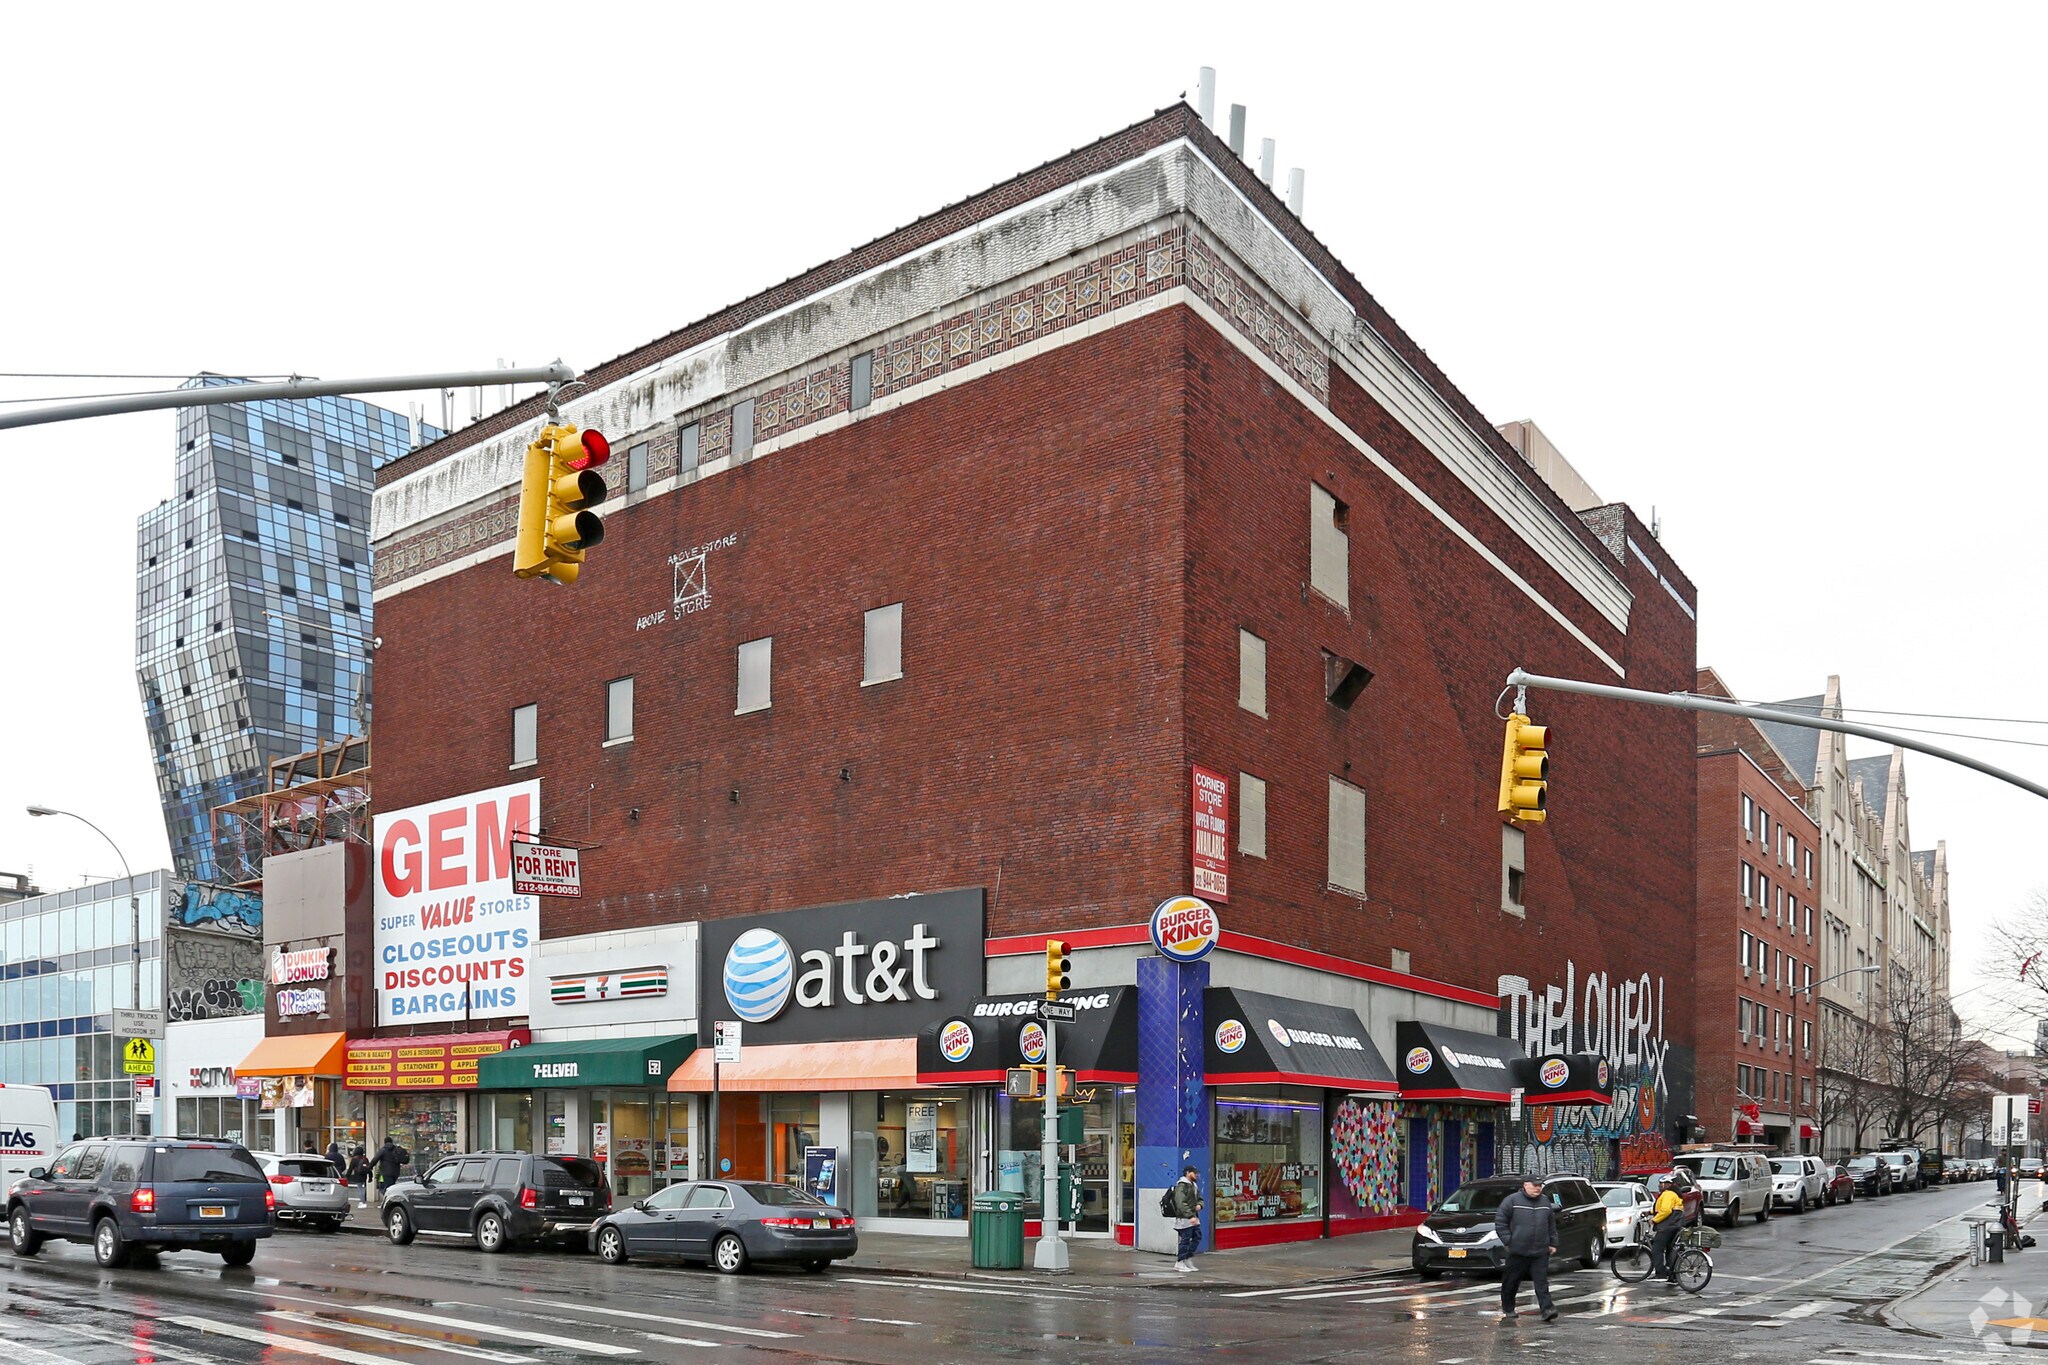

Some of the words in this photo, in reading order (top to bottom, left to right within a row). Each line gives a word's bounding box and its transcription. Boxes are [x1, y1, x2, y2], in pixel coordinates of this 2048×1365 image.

[702, 532, 737, 552] STORE
[636, 610, 667, 631] ABOVE
[674, 594, 712, 620] STORE
[1195, 773, 1225, 794] CORNER
[1199, 788, 1222, 807] STORE
[1208, 805, 1214, 814] &
[1196, 812, 1209, 829] UPPER
[1210, 816, 1225, 834] FLOORS
[381, 793, 530, 898] GEM
[531, 847, 561, 858] STORE
[1196, 829, 1225, 860] AVAILABLE
[516, 856, 541, 875] FOR
[545, 858, 576, 878] RENT
[1206, 860, 1216, 869] CALL
[518, 883, 578, 895] 212-944-0055
[1203, 871, 1225, 893] 944-0055
[381, 914, 415, 930] SUPER
[421, 896, 476, 930] VALUE
[480, 896, 530, 916] STORES
[1160, 908, 1211, 930] BURGER
[1161, 919, 1213, 947] KING
[383, 928, 528, 964] CLOSEOUTS
[287, 949, 329, 967] DUNKIN'
[795, 923, 940, 1008] at&t
[287, 964, 326, 982] DONUTS
[385, 957, 524, 990] DISCOUNTS
[296, 989, 320, 1001] baskin
[392, 987, 516, 1016] BARGAINS
[138, 1012, 158, 1020] TRUCKS
[296, 1002, 320, 1013] robbins
[973, 1000, 1038, 1017] BURGE
[1042, 1006, 1054, 1015] ONE
[1059, 1008, 1071, 1016] WAY
[1498, 974, 1564, 1058] THE
[944, 1027, 968, 1044] BURGER
[1023, 1030, 1043, 1043] BURGER
[1220, 1025, 1242, 1038] BURGER
[1220, 1030, 1243, 1046] KING
[1287, 1028, 1336, 1047] BURGER
[1332, 1035, 1364, 1050] KING
[418, 1048, 443, 1056] DETERGENTS
[452, 1046, 477, 1054] HOUSEHOLD
[946, 1034, 970, 1053] KING
[1023, 1038, 1044, 1053] KING
[1410, 1051, 1428, 1062] BURGER
[1410, 1056, 1430, 1068] KING
[1454, 1052, 1486, 1066] BURGER
[1483, 1056, 1506, 1070] KING
[1544, 1064, 1564, 1075] BURGER
[1544, 1068, 1566, 1082] KING
[406, 1076, 434, 1084] LUGGAGE
[908, 1106, 935, 1116] FREE
[1282, 1165, 1287, 1180] 2
[1262, 1206, 1276, 1218] DOGS
